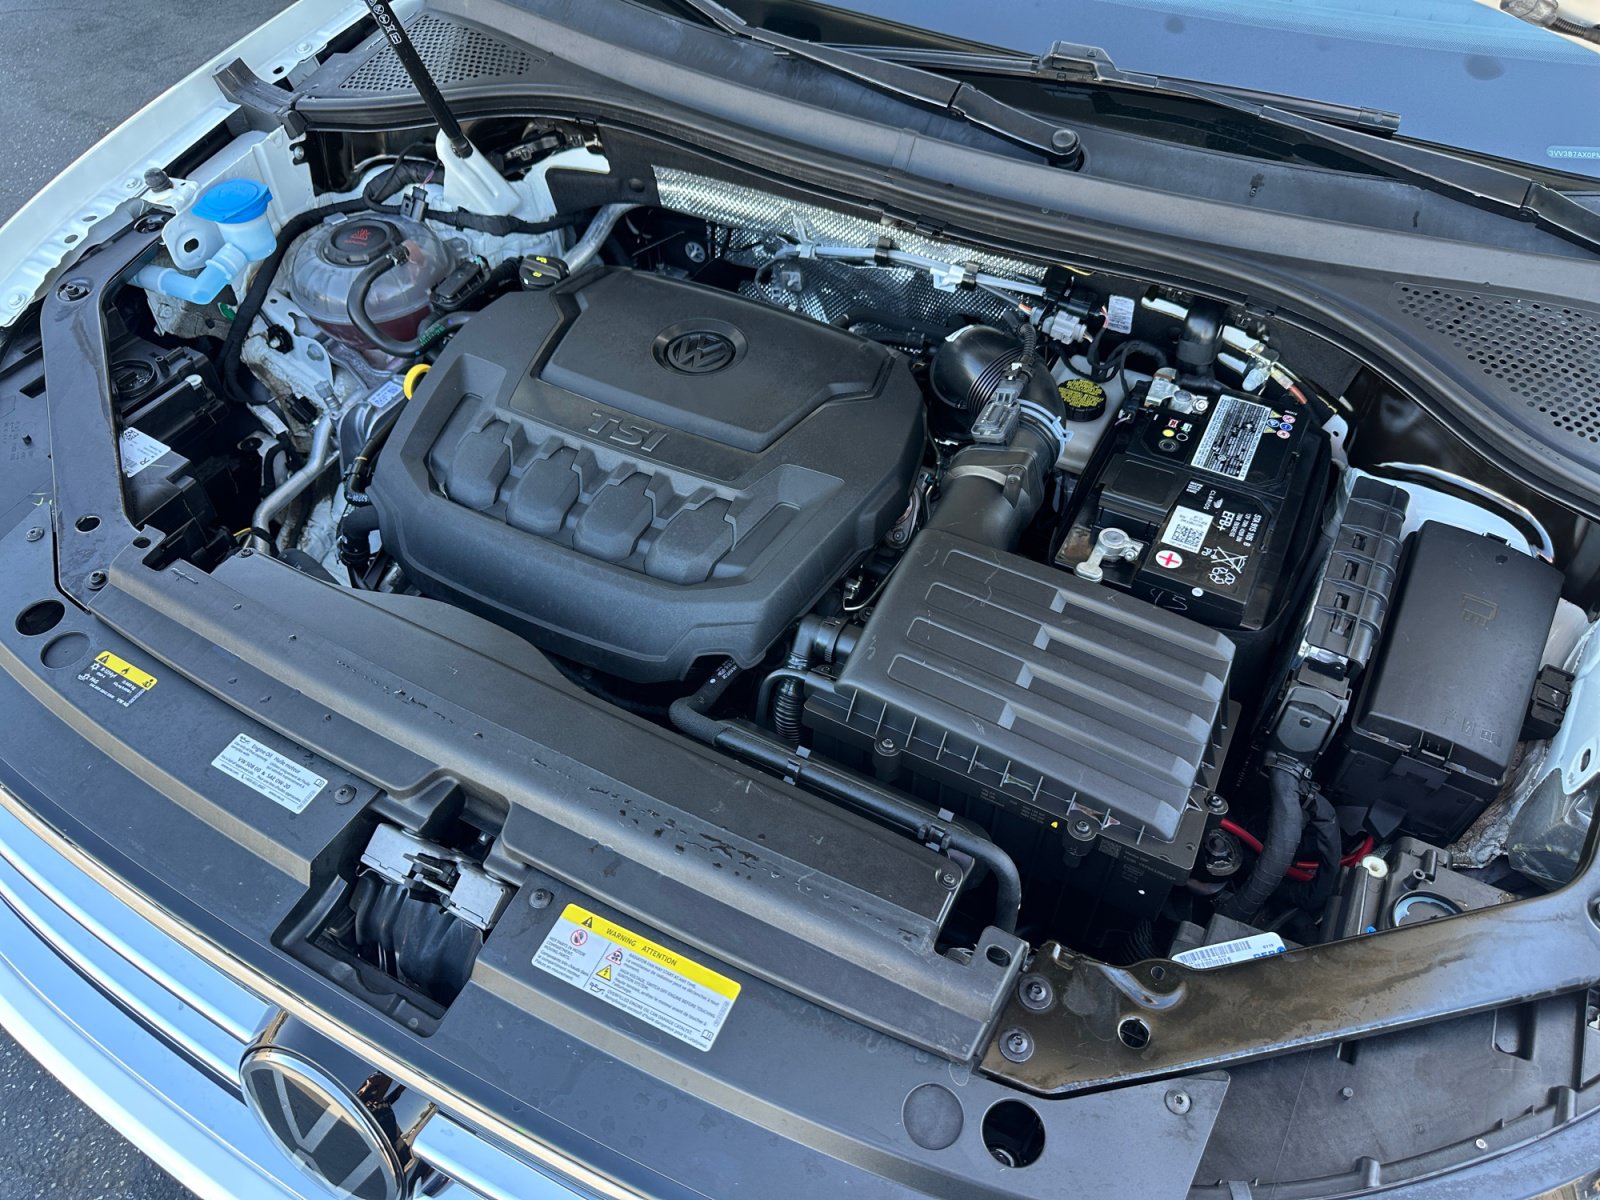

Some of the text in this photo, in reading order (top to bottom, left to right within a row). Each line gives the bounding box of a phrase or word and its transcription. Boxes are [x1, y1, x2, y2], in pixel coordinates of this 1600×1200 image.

[588, 409, 670, 452] TSI
[1204, 490, 1216, 510] CLARIOS
[1216, 510, 1235, 531] EFB+
[1201, 546, 1212, 557] Pb
[251, 744, 266, 754] Engine
[274, 756, 286, 765] Huile
[286, 763, 301, 773] moteur
[606, 928, 677, 966] WARNING ATTENTION
[630, 960, 651, 972] ventilateur
[656, 972, 672, 983] radiateur
[607, 989, 629, 1003] OVERFILLED
[629, 1000, 643, 1010] ENGINE
[658, 1014, 673, 1025] DAMAGE
[658, 999, 672, 1008] moteur
[672, 1006, 683, 1014] avant
[667, 991, 681, 1001] ENGINE
[681, 998, 696, 1008] BEFORE
